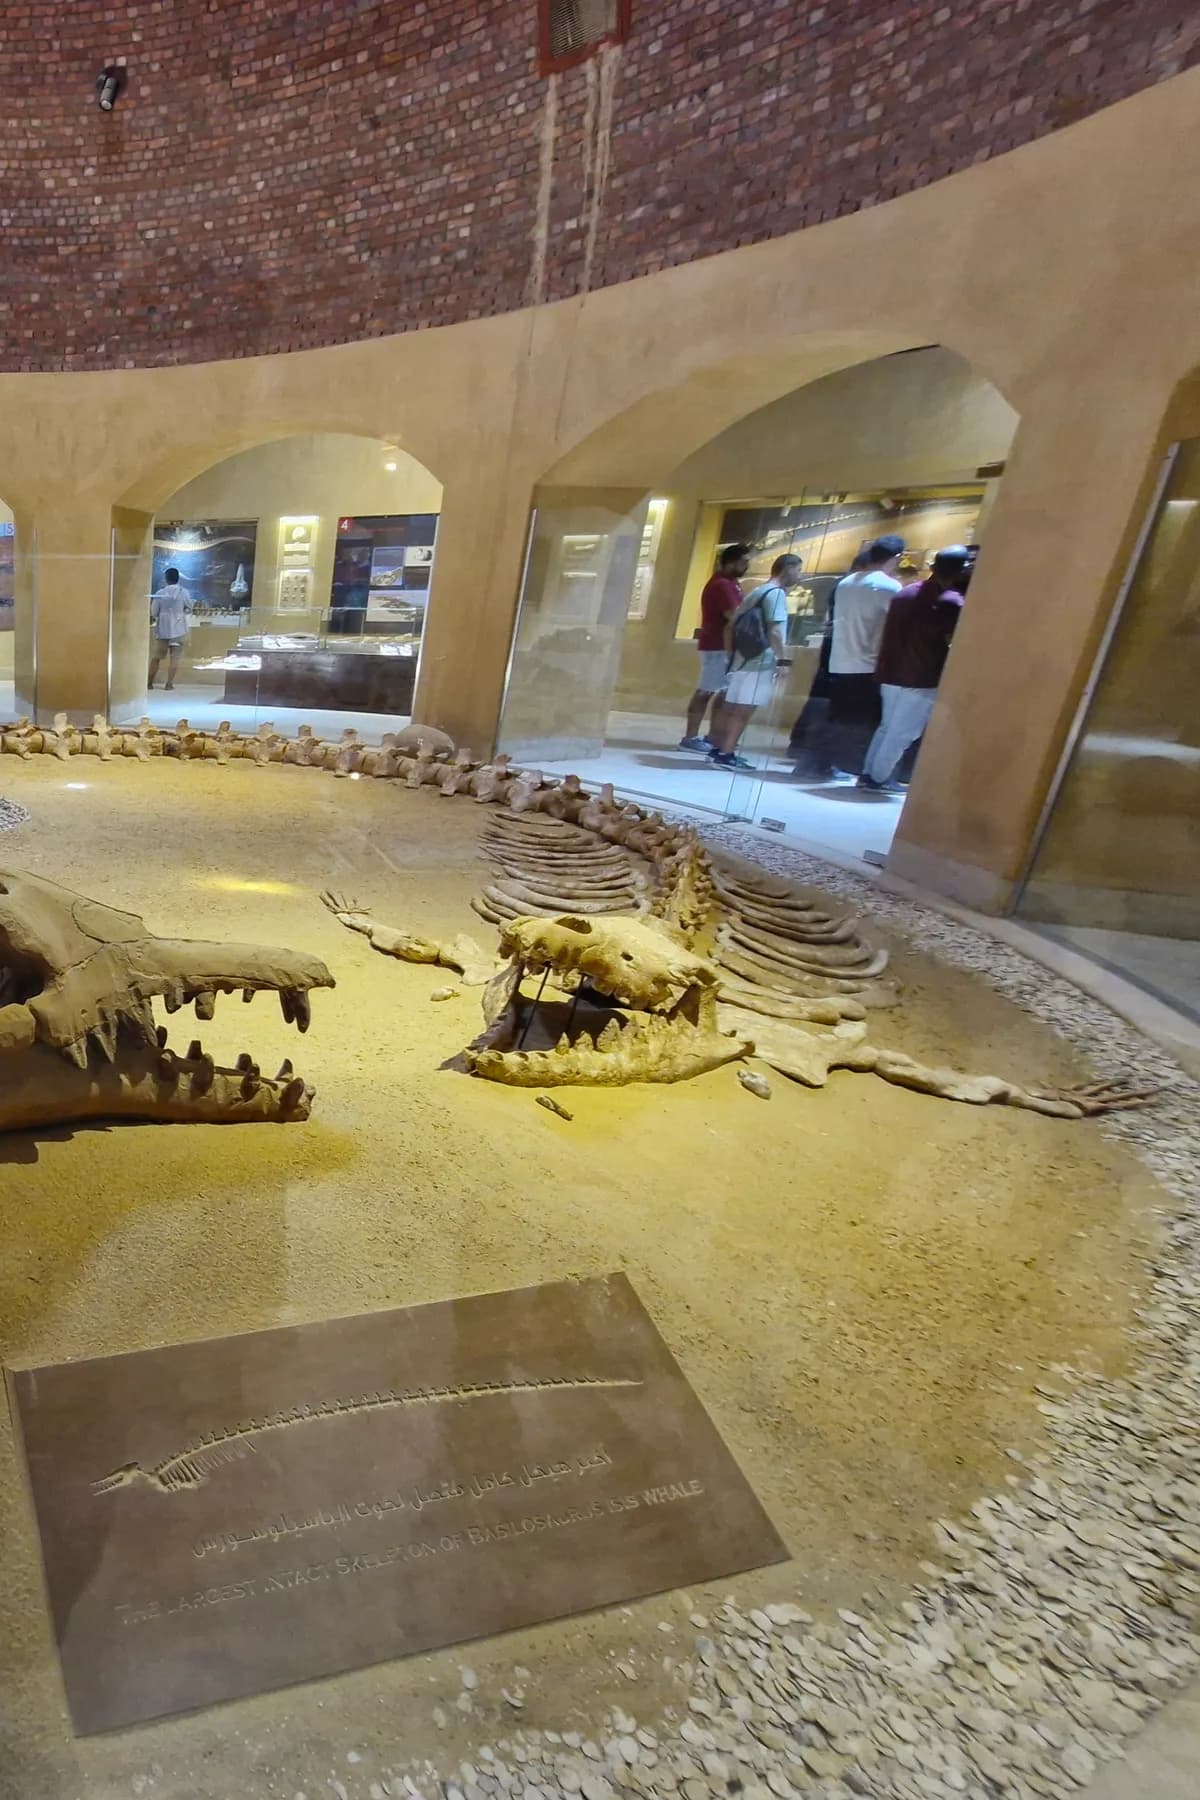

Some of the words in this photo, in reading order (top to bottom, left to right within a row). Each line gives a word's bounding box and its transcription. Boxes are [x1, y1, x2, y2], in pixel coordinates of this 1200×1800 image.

[7, 524, 13, 534] 5
[341, 519, 349, 530] 4
[469, 1470, 515, 1499] كامل
[520, 1460, 572, 1489] هيكل
[354, 1493, 405, 1520] لحوت
[410, 1481, 465, 1511] متصل
[168, 1579, 256, 1615] LARGEST
[264, 1563, 331, 1593] INTACT
[335, 1542, 437, 1575] SKELETON
[440, 1533, 462, 1552] OF
[468, 1500, 604, 1546] BASILOSAURUS
[609, 1495, 641, 1514] ISIS
[643, 1479, 704, 1506] WHALE
